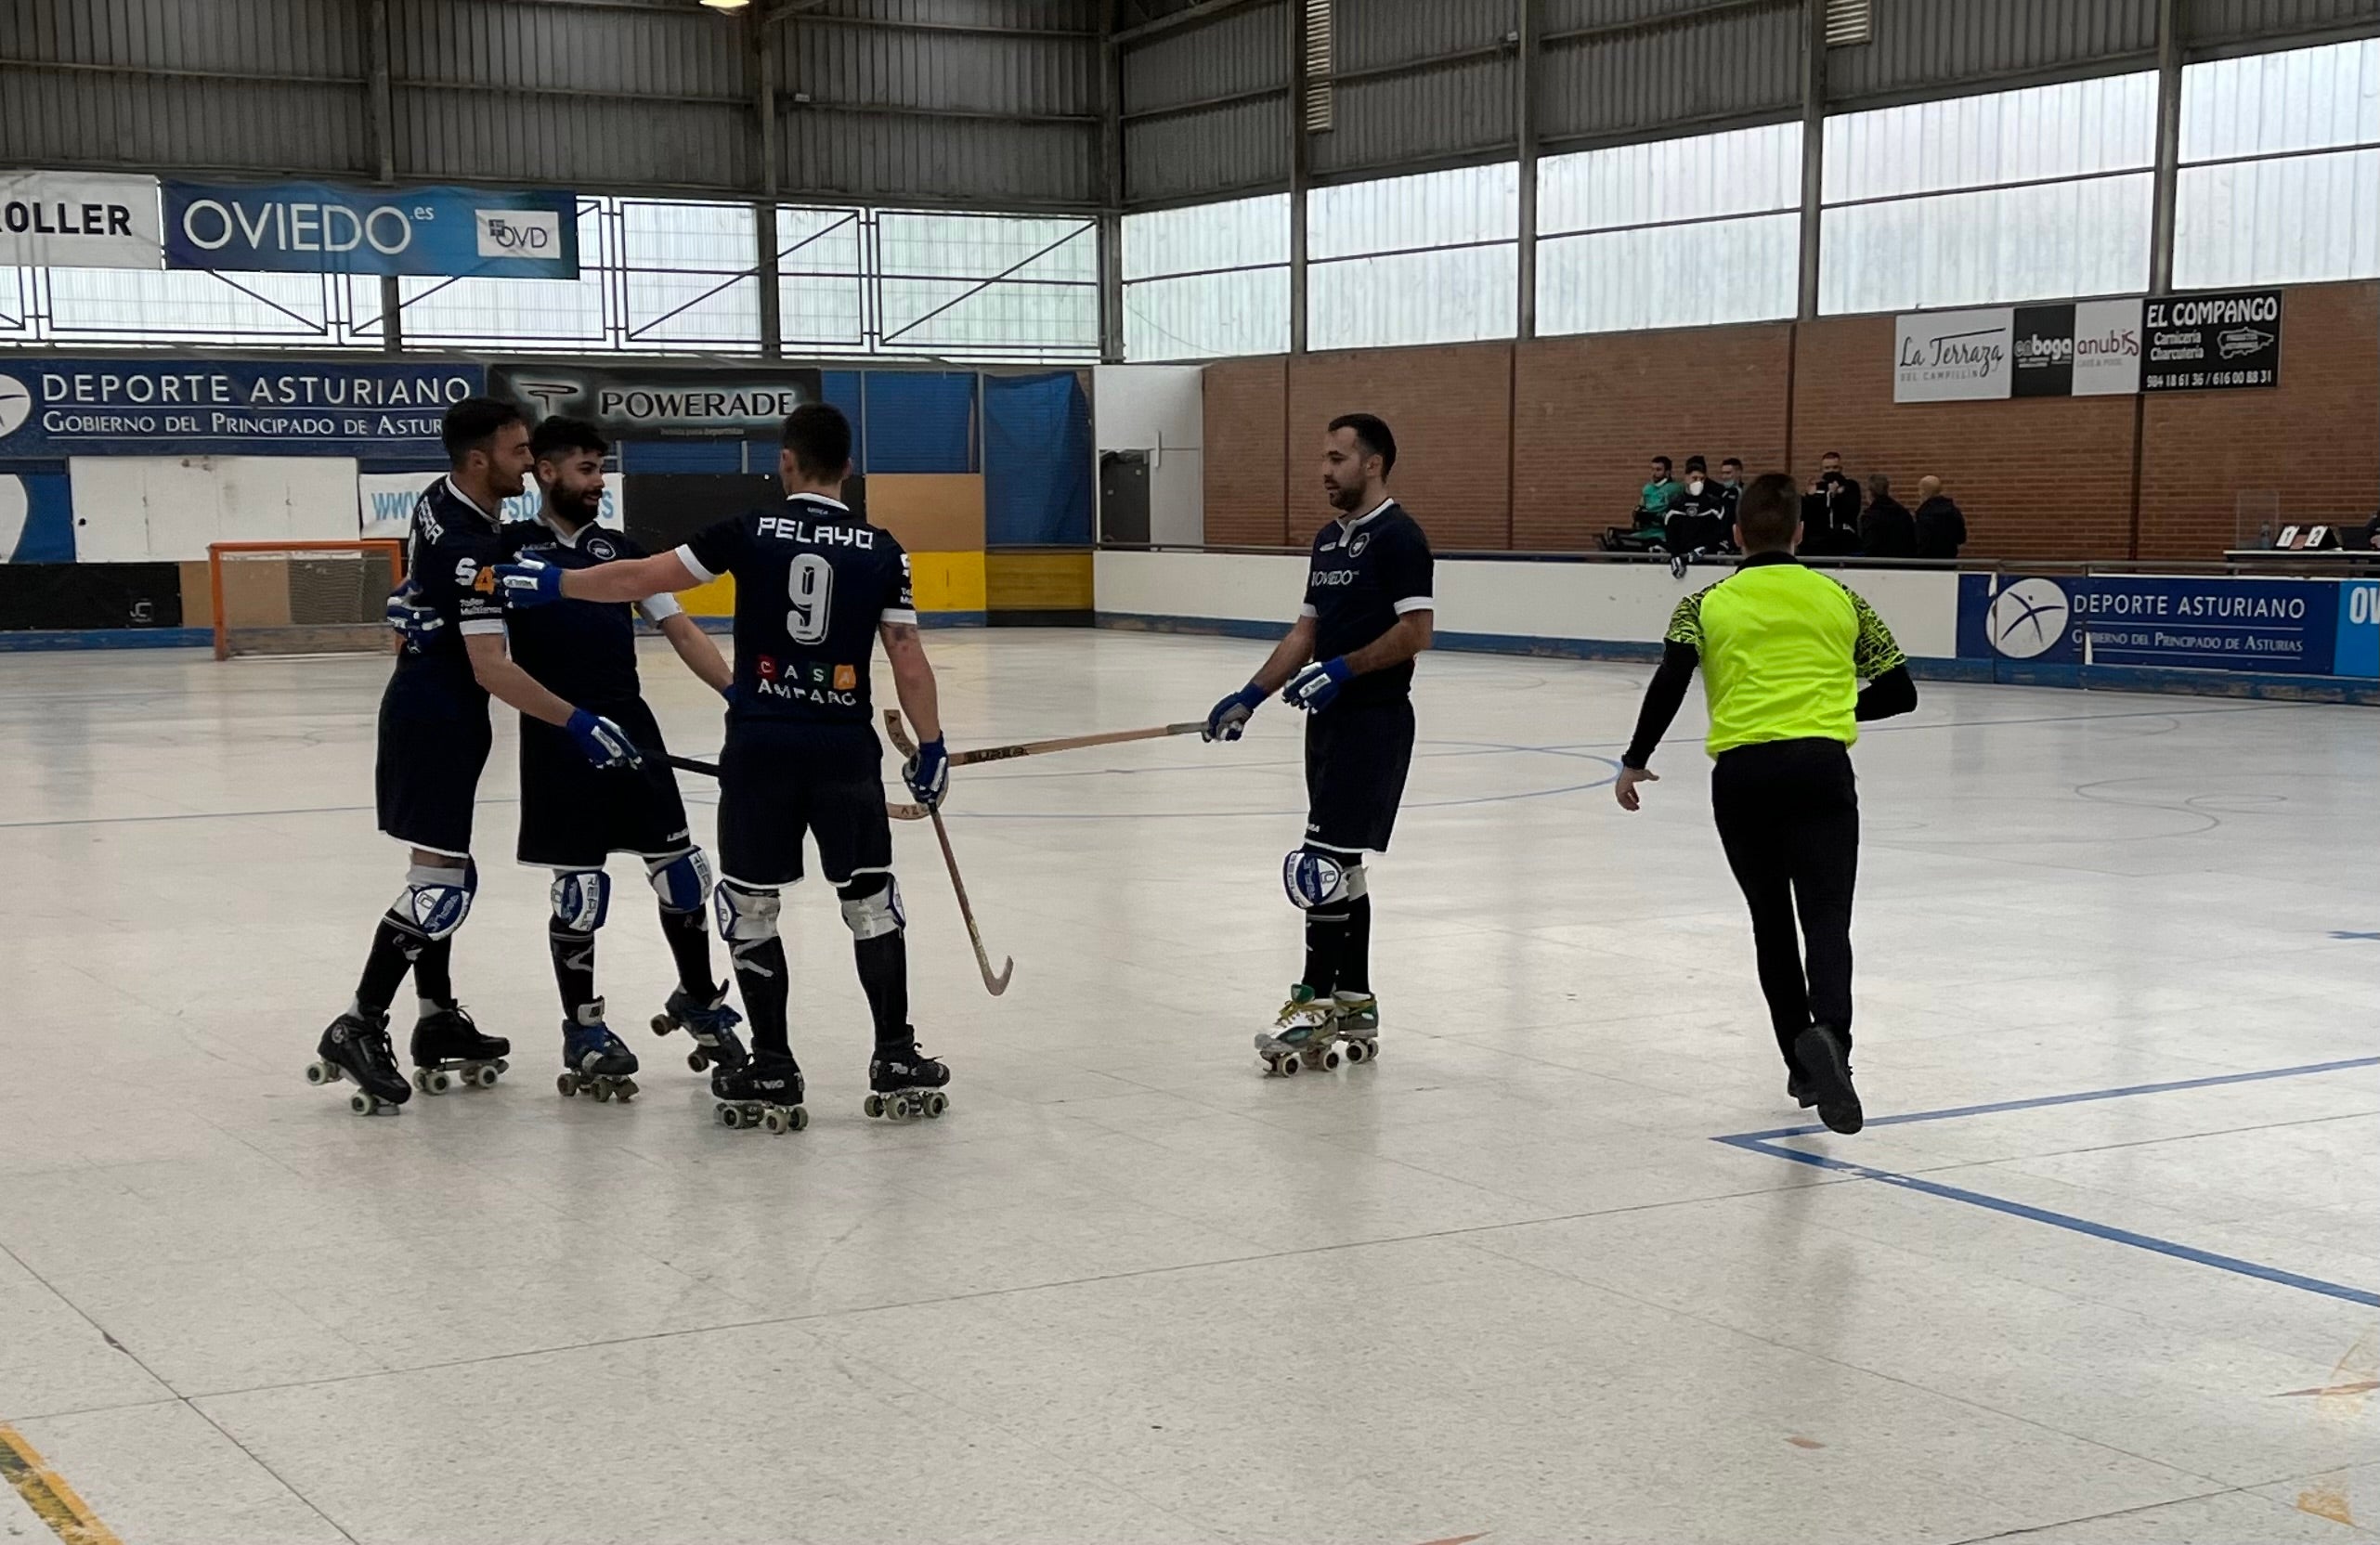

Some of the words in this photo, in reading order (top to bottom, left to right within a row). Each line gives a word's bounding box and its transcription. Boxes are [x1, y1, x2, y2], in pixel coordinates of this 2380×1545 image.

[0, 201, 132, 236] OLLER
[183, 199, 411, 254] OVIEDO
[496, 226, 548, 249] OVD
[2147, 305, 2167, 328] EL
[2172, 296, 2278, 326] COMPANGO
[1900, 336, 1925, 367] La
[1930, 328, 2006, 378] Terraza
[43, 373, 230, 403] DEPORTE
[250, 376, 471, 405] ASTURIANO
[2166, 373, 2177, 386] 18
[2232, 370, 2244, 384] 00
[601, 391, 794, 418] POWERADE
[165, 416, 202, 432] DEL
[345, 419, 370, 435] DE
[757, 516, 875, 550] PELAYO
[787, 553, 834, 645] 9
[2074, 594, 2169, 616] DEPORTE
[2177, 596, 2306, 619] ASTURIANO
